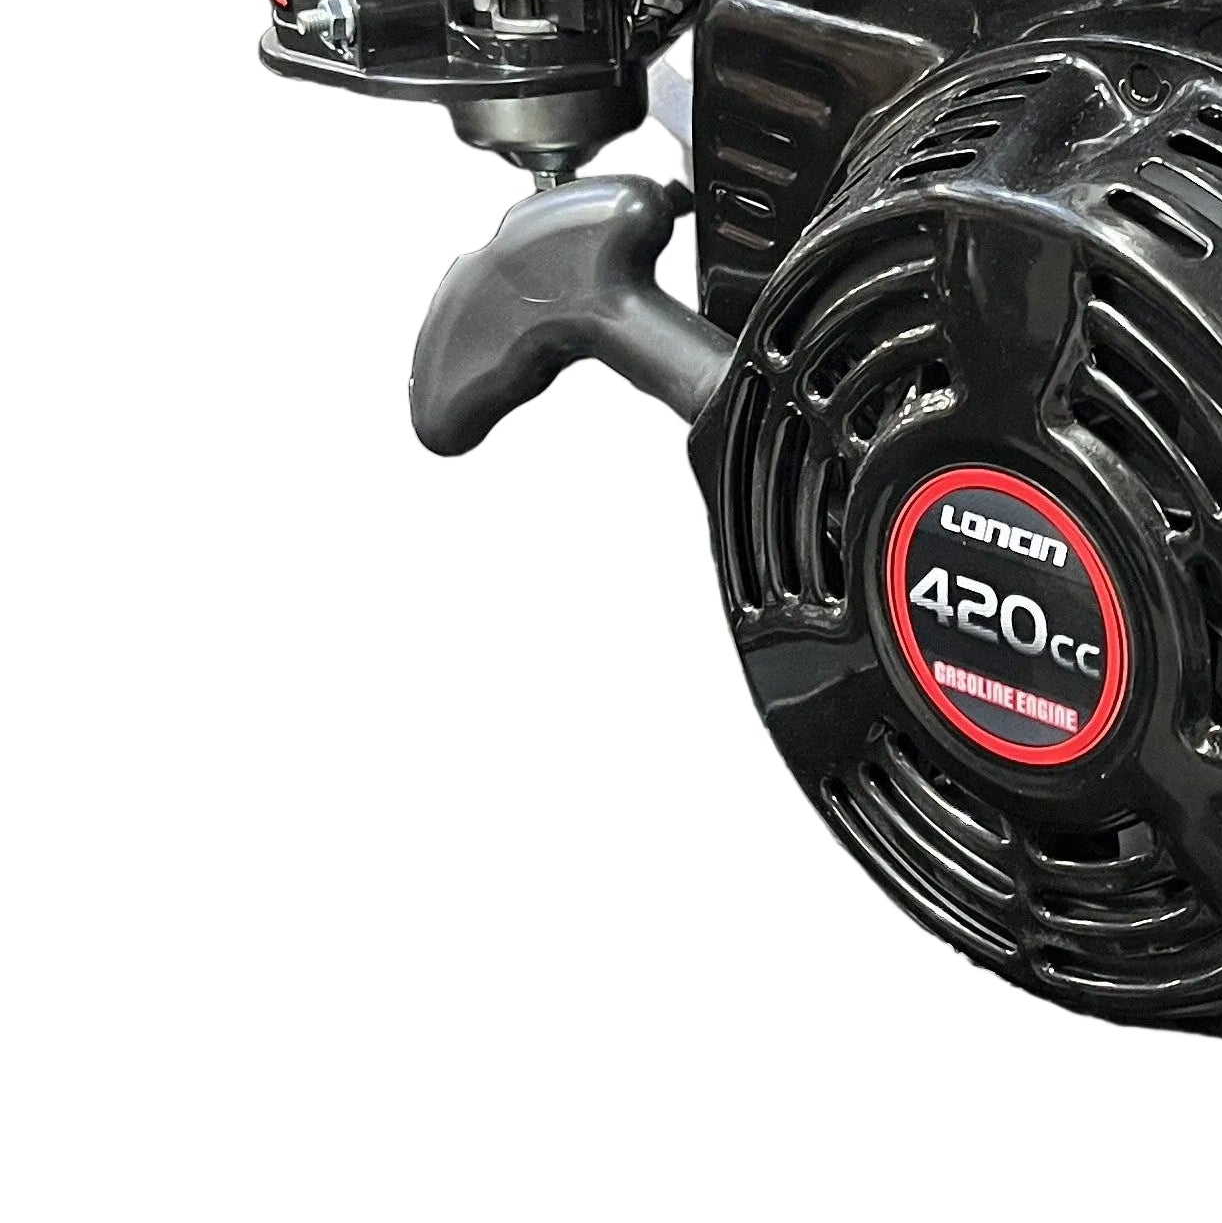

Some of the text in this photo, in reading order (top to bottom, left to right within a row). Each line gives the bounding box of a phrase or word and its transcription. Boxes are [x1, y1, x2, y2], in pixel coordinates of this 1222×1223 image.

[940, 504, 1068, 568] LONCIN
[933, 659, 1080, 734] GASOLINE ENGINE
